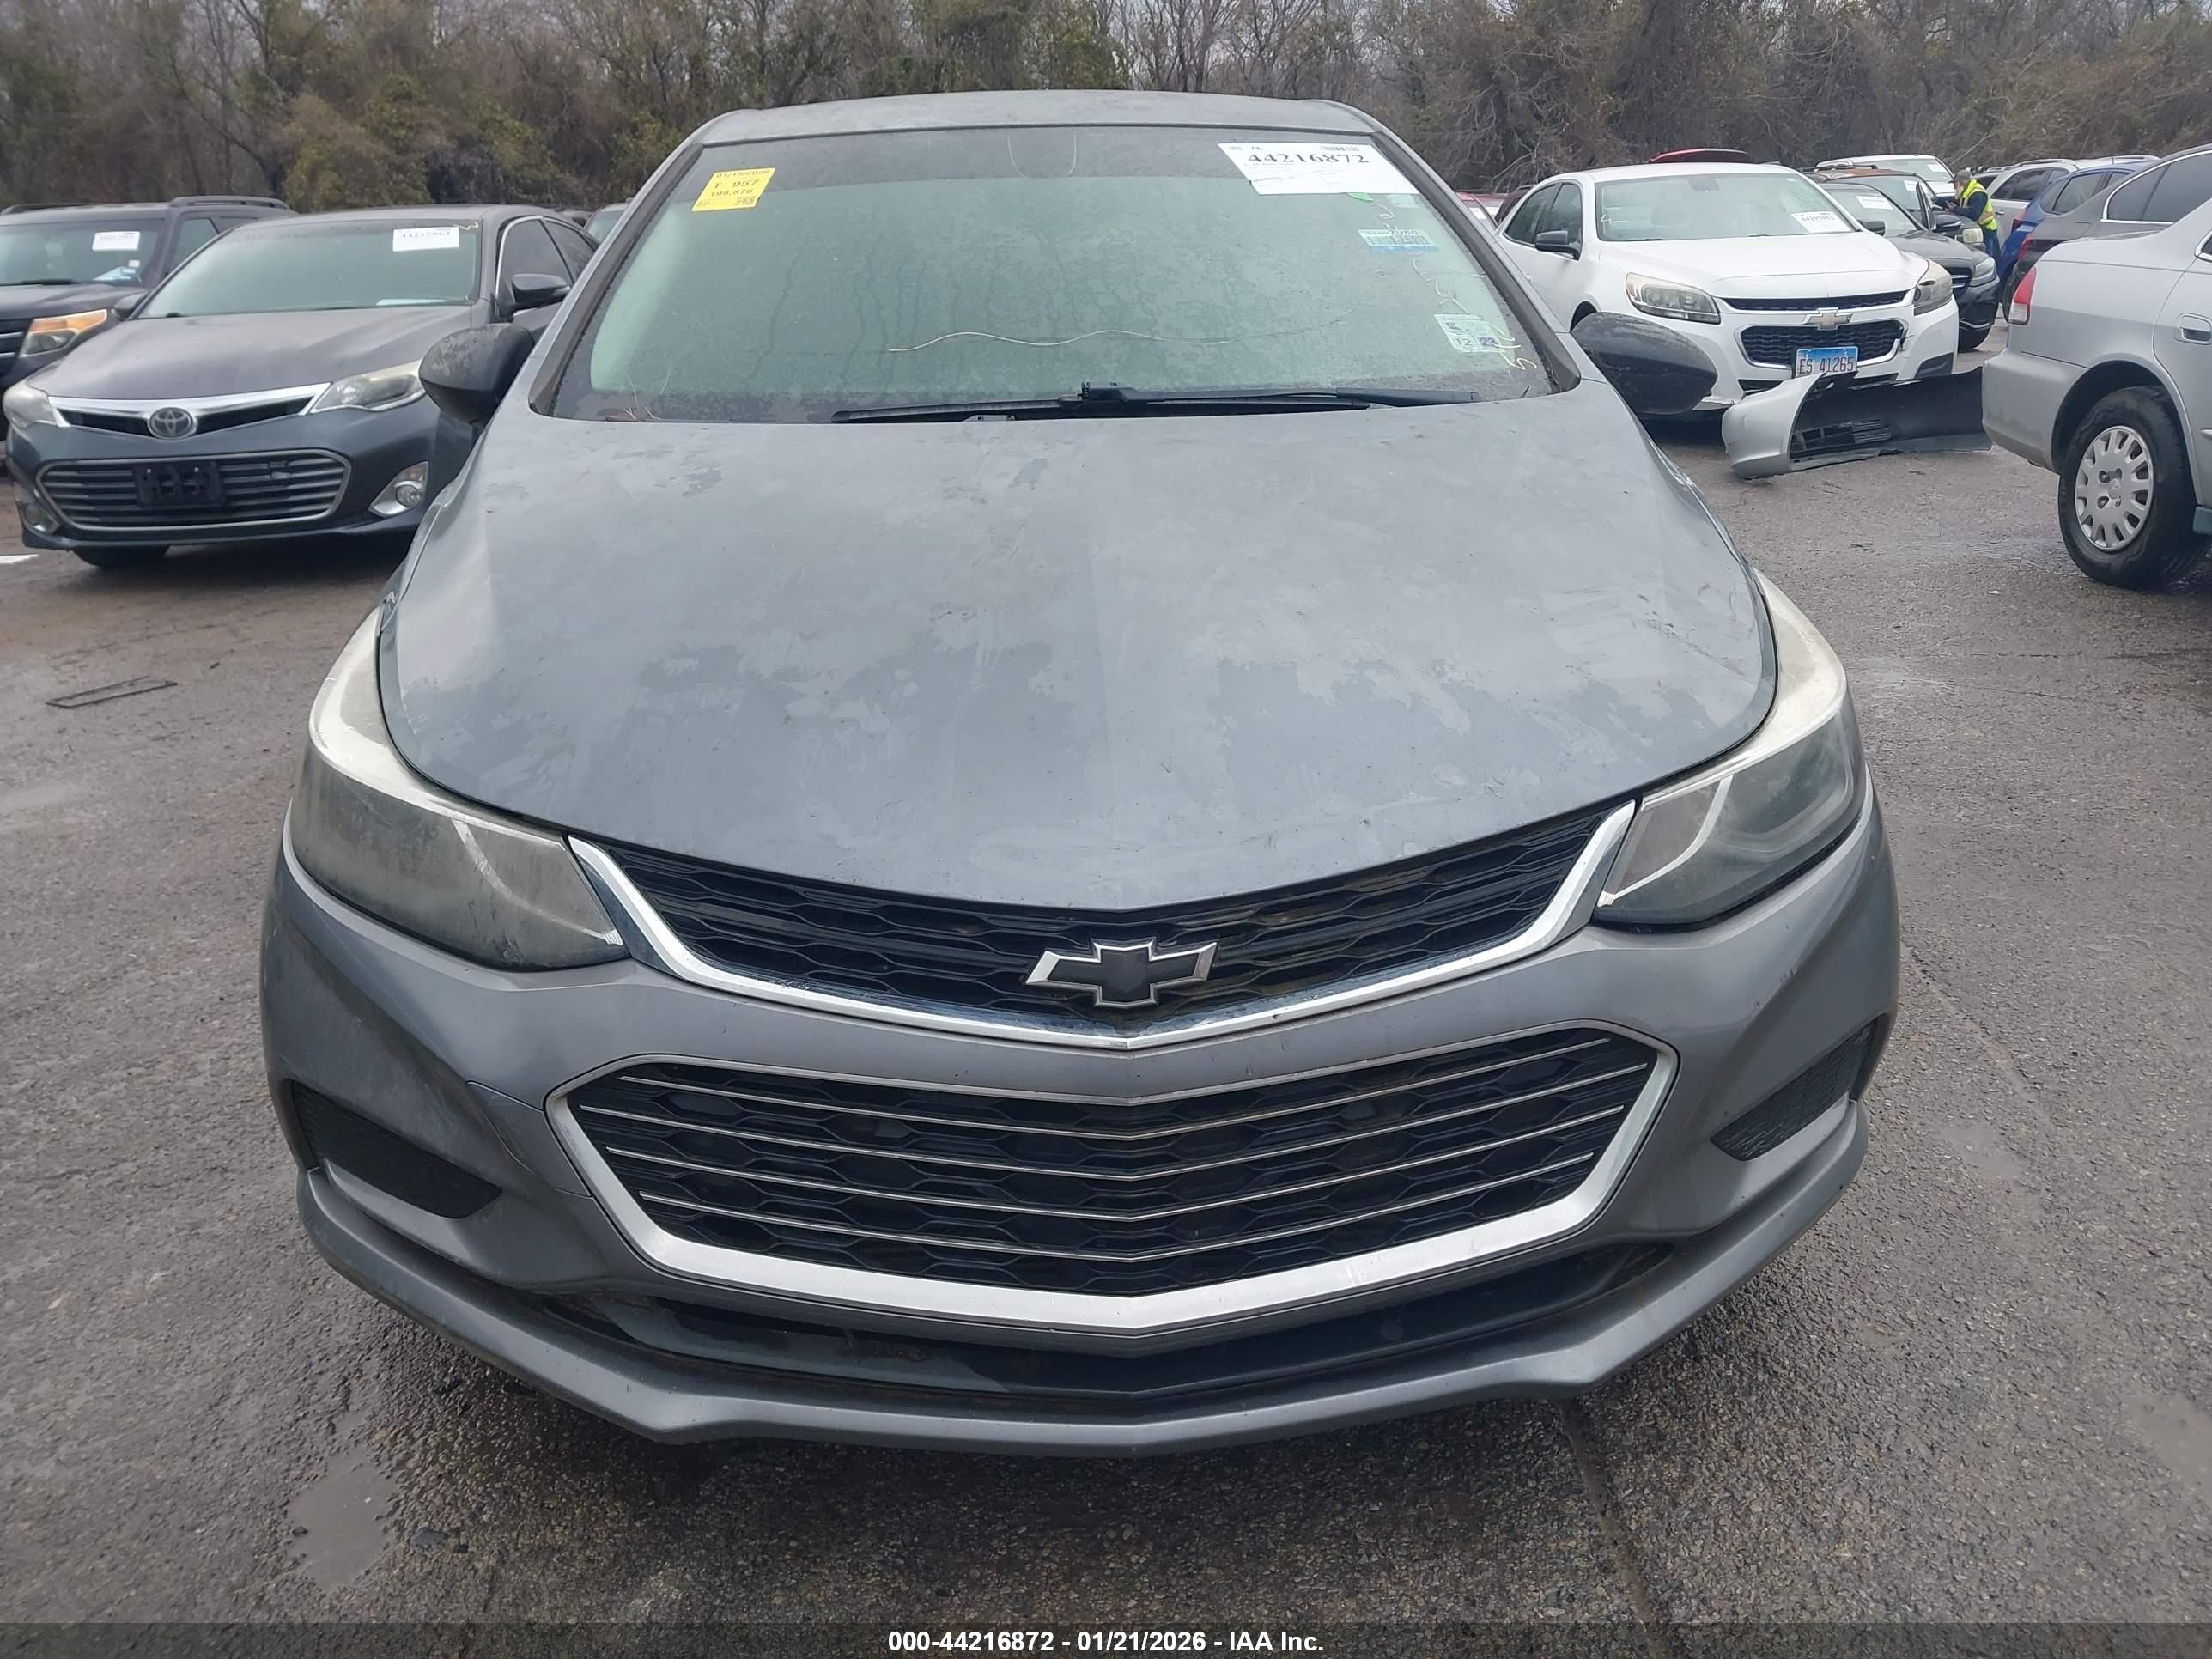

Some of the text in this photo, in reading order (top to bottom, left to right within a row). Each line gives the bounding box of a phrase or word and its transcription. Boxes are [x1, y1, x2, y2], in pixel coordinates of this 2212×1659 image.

[1248, 153, 1370, 164] 44216872
[1799, 356, 1854, 374] ES 41265
